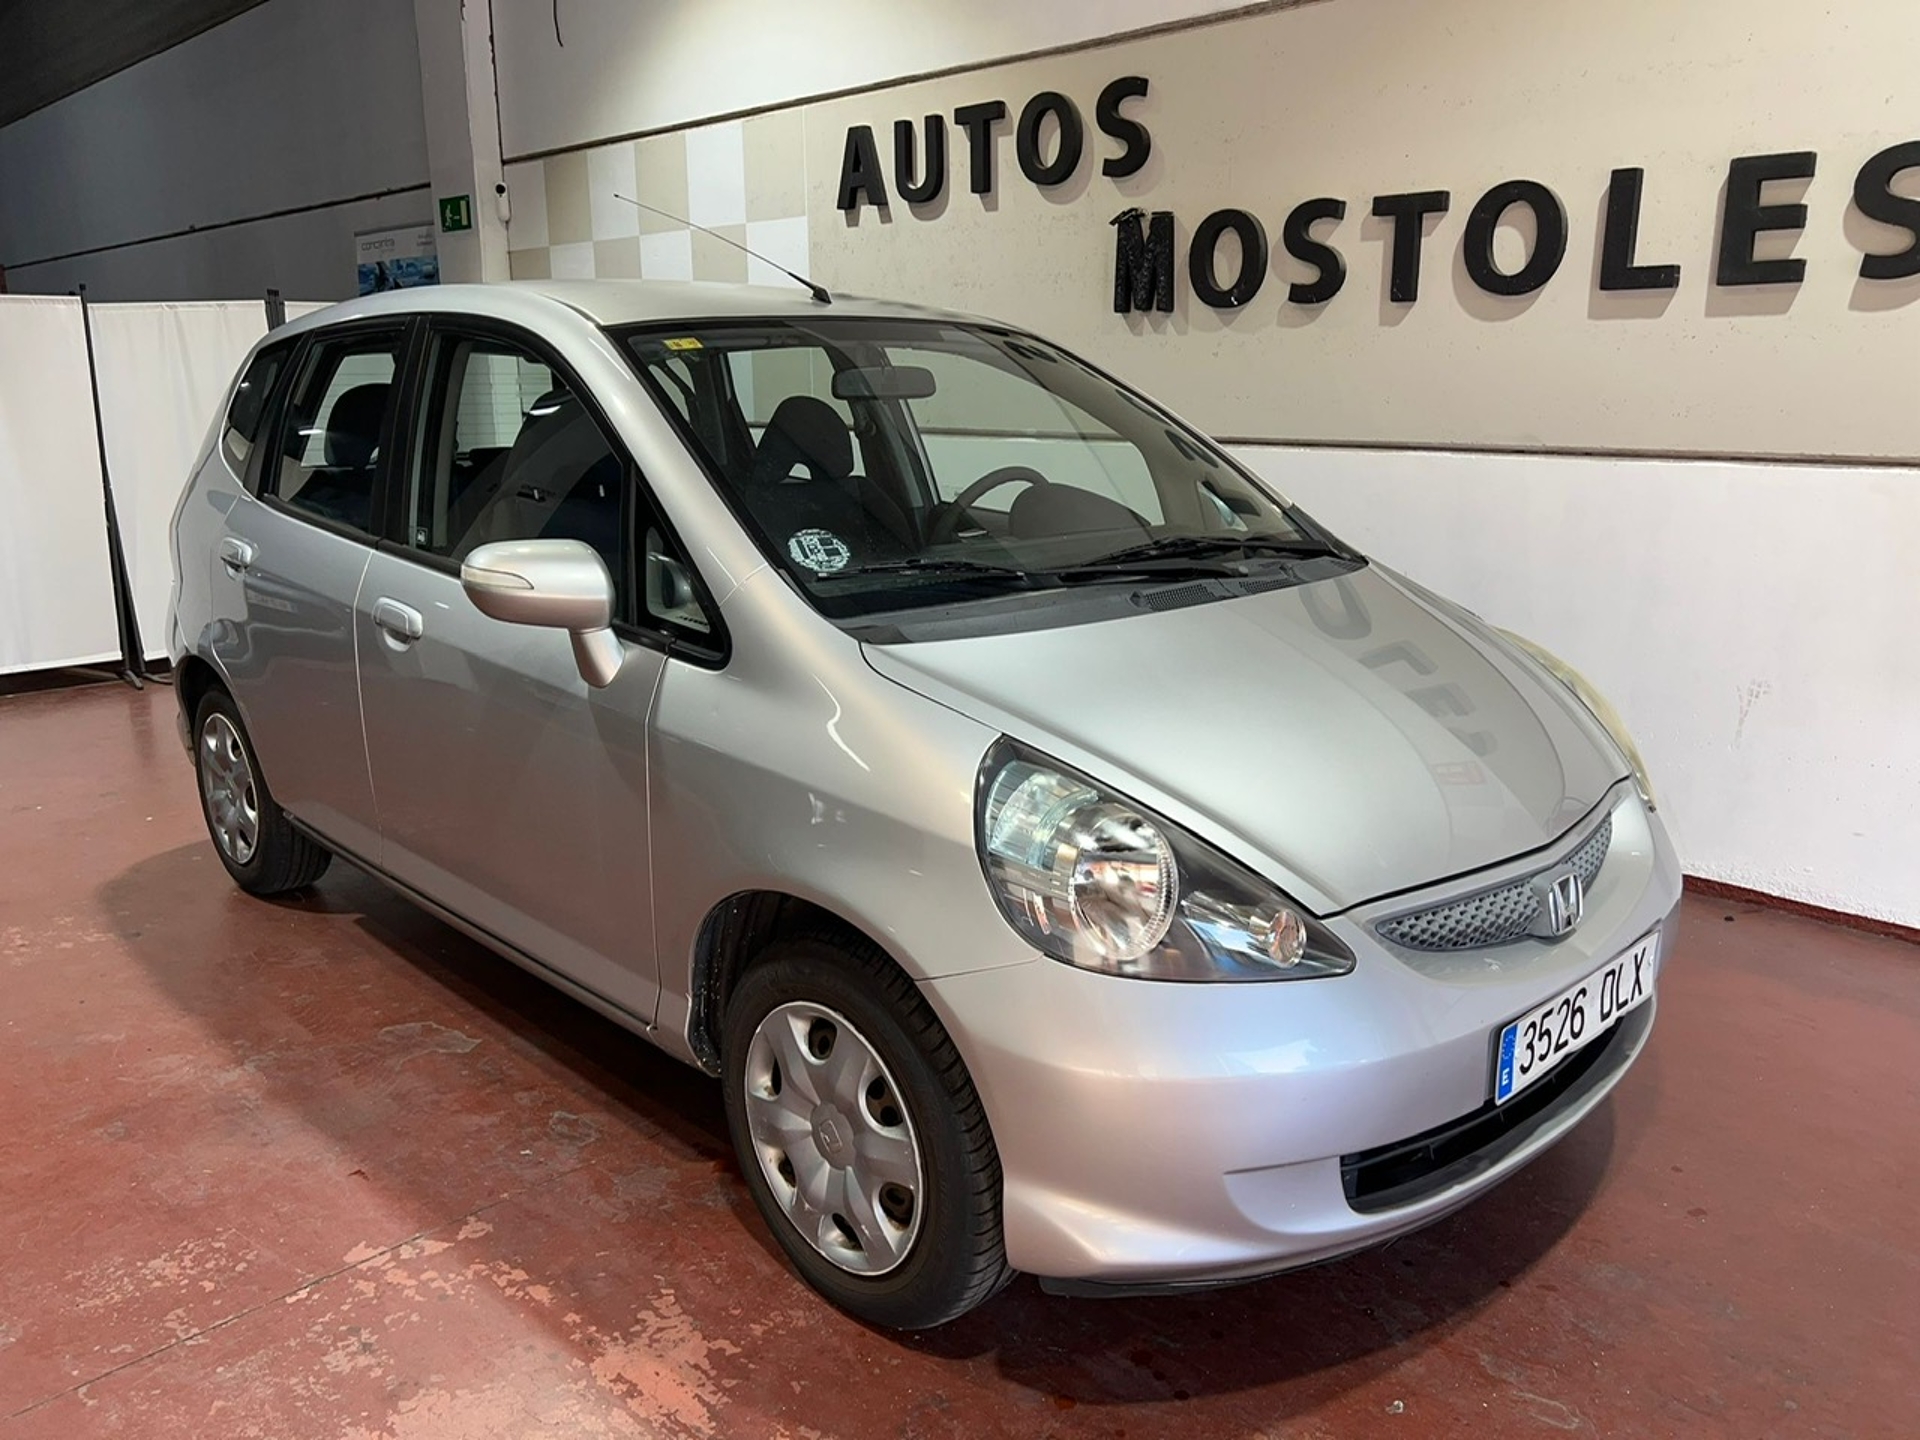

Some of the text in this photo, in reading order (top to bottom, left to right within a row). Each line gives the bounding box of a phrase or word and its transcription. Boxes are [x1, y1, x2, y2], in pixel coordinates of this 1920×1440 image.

[836, 76, 1152, 211] AUTOS
[1109, 139, 1920, 314] MOSTOLES
[1501, 1067, 1510, 1086] E
[1519, 947, 1647, 1075] 3526 DLX
